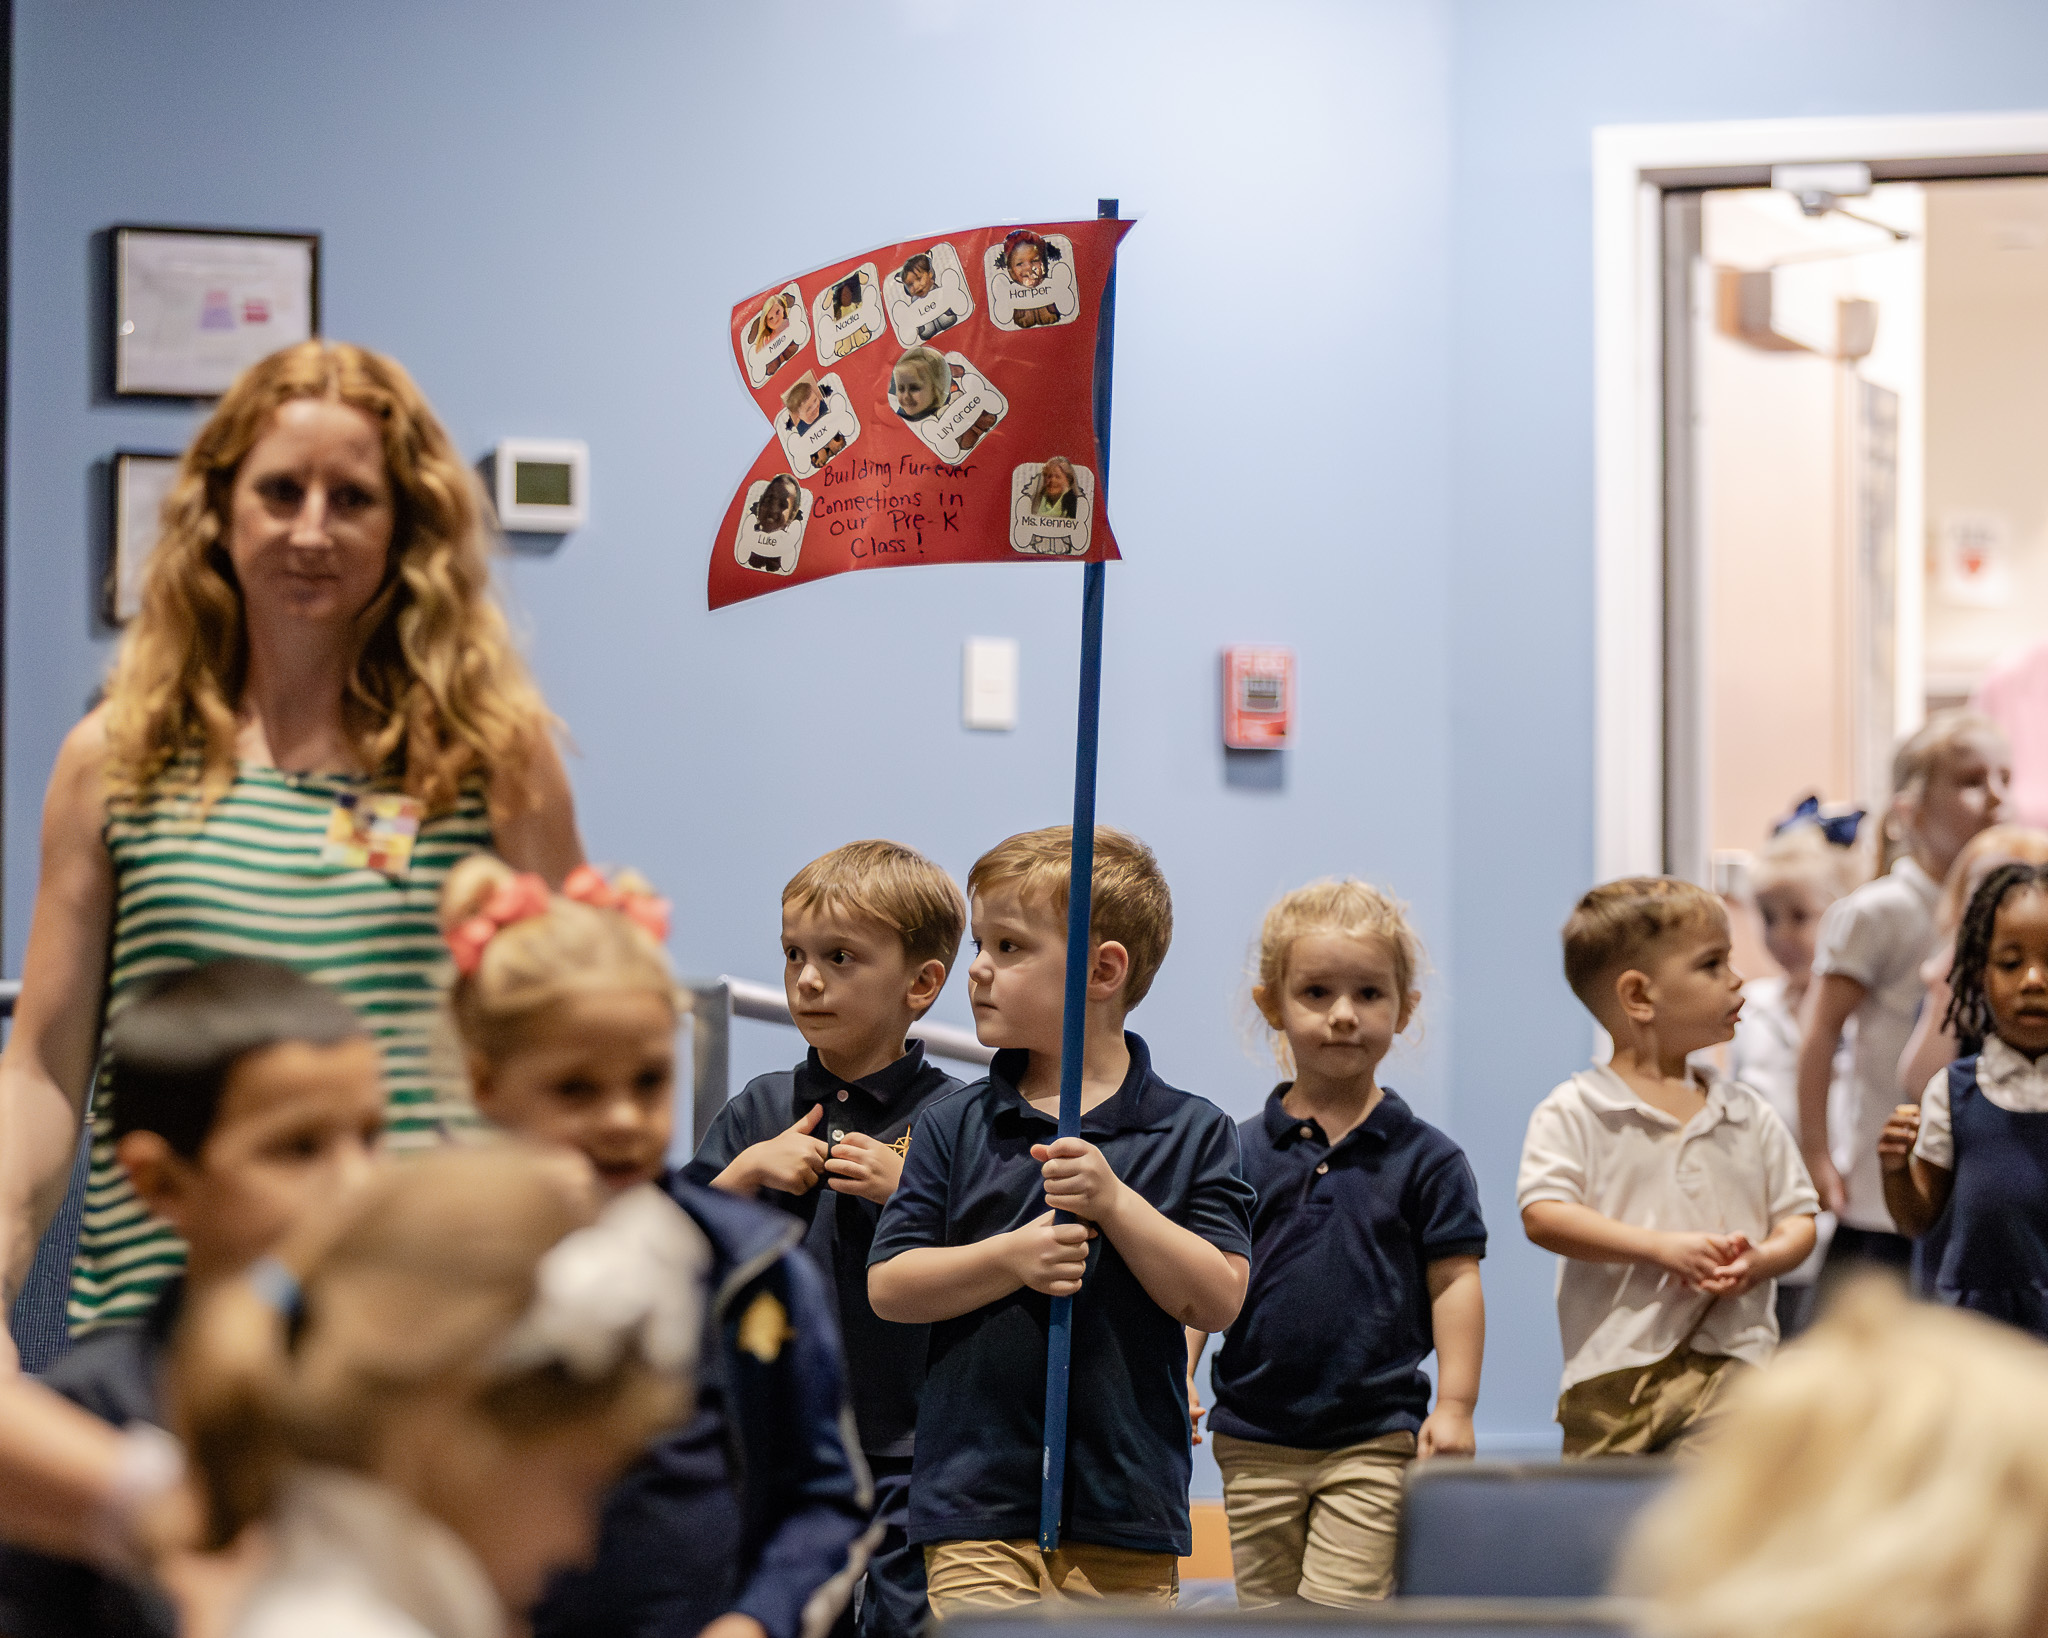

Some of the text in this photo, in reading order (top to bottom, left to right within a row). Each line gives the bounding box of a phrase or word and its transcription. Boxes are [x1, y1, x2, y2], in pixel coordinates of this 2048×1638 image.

[1009, 285, 1052, 300] Harper
[918, 301, 937, 316] Lee
[952, 396, 981, 424] Grace
[809, 426, 828, 444] Max
[824, 454, 978, 488] Building Fur-ever
[812, 489, 964, 519] Connections in
[1021, 516, 1080, 530] Ms. Kenney
[757, 534, 777, 547] Luke
